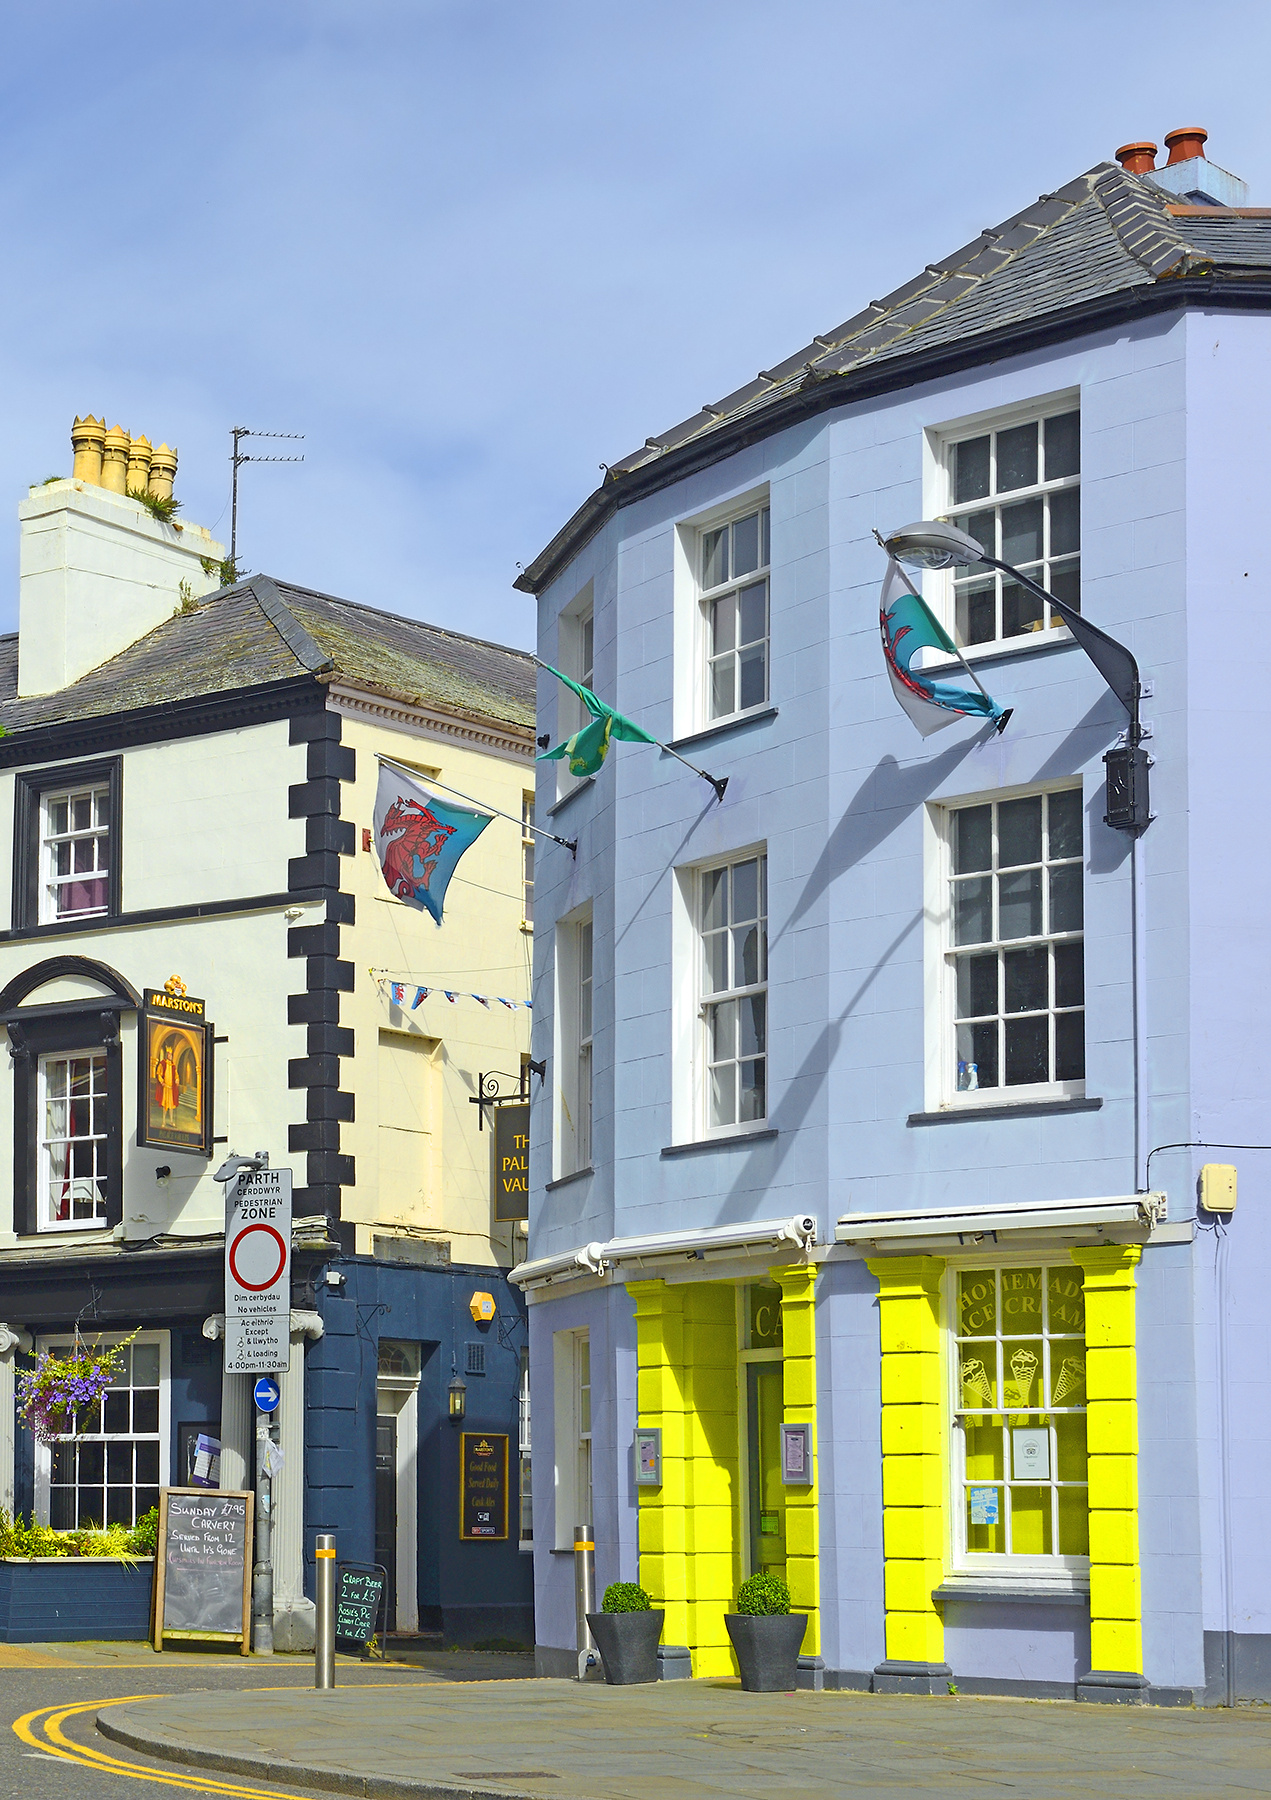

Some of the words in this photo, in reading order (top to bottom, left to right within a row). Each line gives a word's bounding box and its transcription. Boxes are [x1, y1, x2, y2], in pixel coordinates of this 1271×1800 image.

[152, 994, 203, 1015] MARSTON'S
[513, 1134, 530, 1149] TH
[502, 1155, 529, 1171] PAL
[238, 1172, 279, 1185] PARTH
[502, 1177, 530, 1193] VAU
[237, 1186, 281, 1196] CERDDWYR
[234, 1198, 283, 1208] PEDESTRIAN
[241, 1207, 276, 1220] ZONE
[234, 1294, 247, 1302] Dim
[248, 1293, 281, 1302] cerbydau
[249, 1305, 277, 1313] vehicles
[251, 1318, 274, 1326] eithrio
[962, 1303, 996, 1336] ICE
[245, 1328, 269, 1336] Except
[246, 1337, 252, 1345] &
[252, 1336, 279, 1345] llwytho
[246, 1350, 252, 1358] &
[253, 1349, 279, 1358] loading
[171, 1503, 217, 1516] SUNDAY
[191, 1517, 235, 1531] CARVERY
[225, 1533, 235, 1543] 12
[365, 1576, 382, 1589] BEER
[341, 1585, 348, 1598] 2
[362, 1589, 376, 1603] £5
[336, 1624, 342, 1635] 2
[354, 1627, 366, 1639] £5
